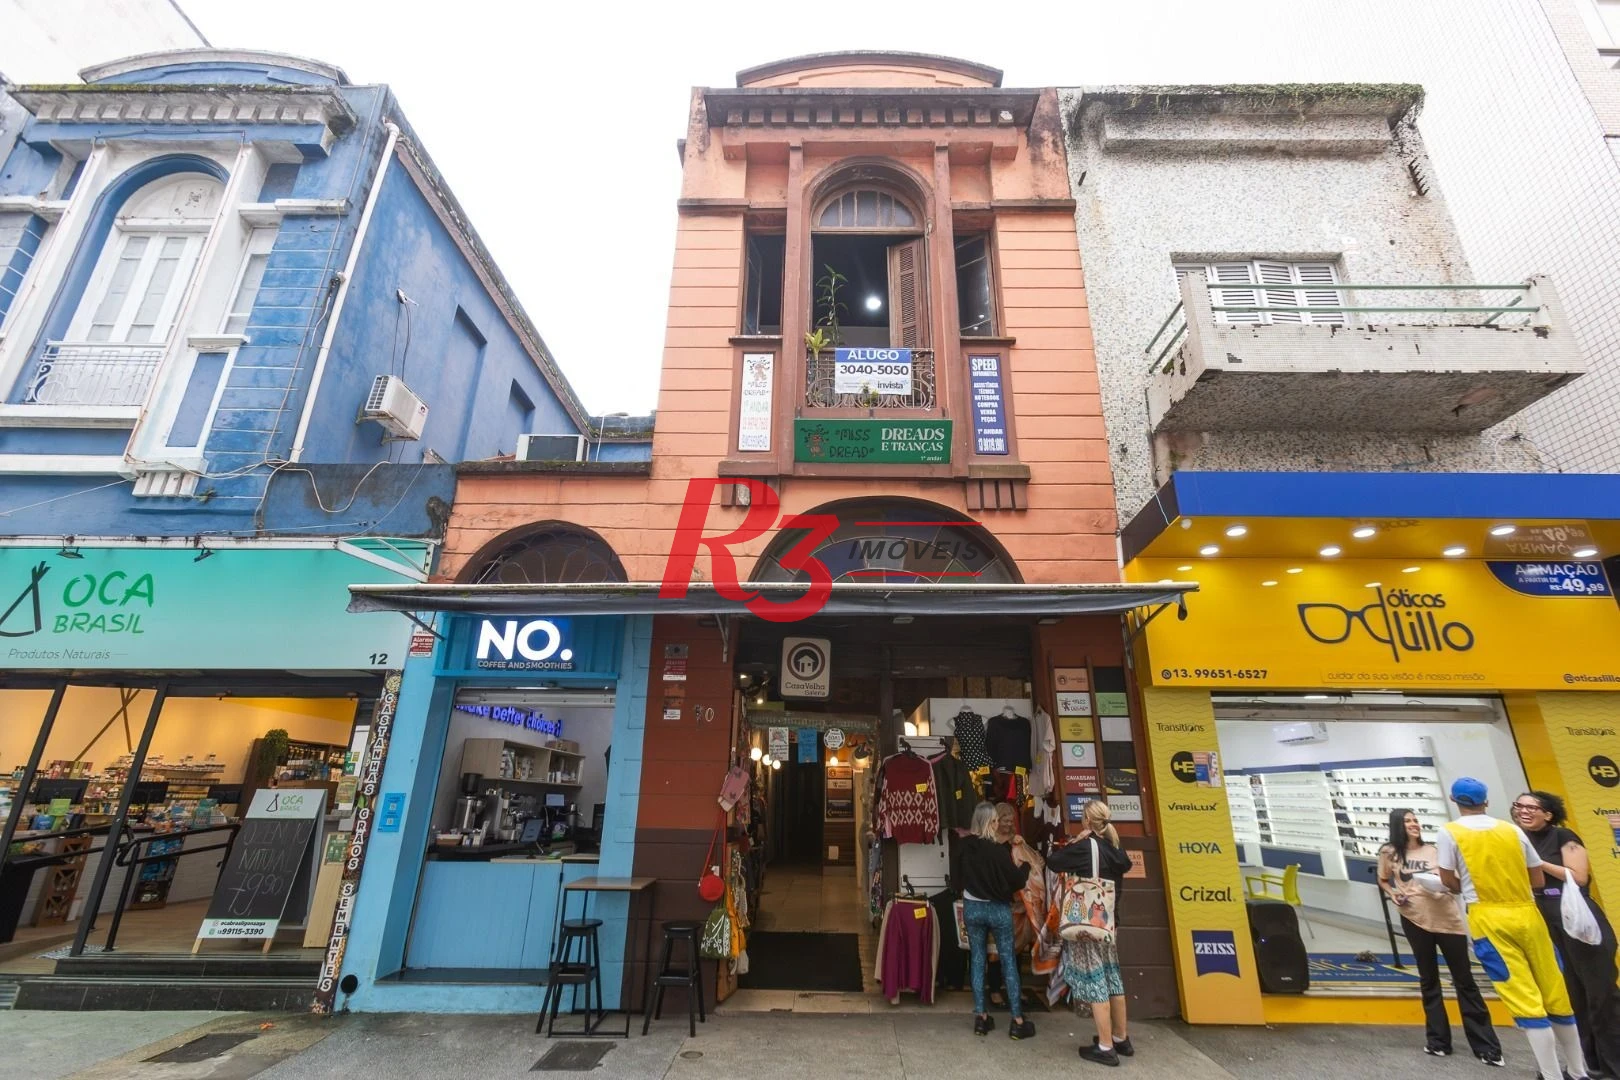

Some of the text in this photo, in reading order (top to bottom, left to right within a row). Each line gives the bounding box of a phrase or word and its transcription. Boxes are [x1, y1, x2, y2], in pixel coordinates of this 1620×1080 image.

[847, 349, 899, 361] ALUGO
[840, 365, 909, 375] 3040-5050
[972, 358, 998, 371] SPEED
[877, 381, 904, 389] invista
[881, 428, 945, 441] DREADS
[881, 442, 944, 453] E TRANÇAS
[1515, 562, 1599, 578] ARMAÇÃO
[63, 570, 154, 608] OCA
[1562, 578, 1605, 595] 49,99
[1387, 588, 1446, 608] óticas
[53, 612, 144, 634] BRASIL
[476, 619, 573, 661] NO.
[8, 648, 111, 660] Produtos Naturais
[368, 653, 388, 665] 12
[478, 660, 506, 668] COFFEE
[526, 661, 573, 670] SMOOTHIES
[1194, 669, 1268, 680] 99651-6527
[1328, 671, 1355, 680] cuidar
[1358, 671, 1370, 680] da
[1391, 671, 1415, 680] visão
[1417, 671, 1423, 680] é
[1425, 673, 1450, 681] nossa
[1453, 671, 1486, 681] missão
[1156, 722, 1205, 732] Transitions
[1566, 726, 1617, 736] Transitions
[364, 693, 393, 796] CASTANHAS
[1591, 765, 1618, 778] HB
[282, 794, 304, 806] OCA
[348, 808, 370, 870] GRÃOS
[1179, 842, 1221, 854] HOYA
[1180, 886, 1231, 902] Crizal
[320, 883, 354, 993] SEMENTES
[1194, 942, 1235, 955] ZEISS
